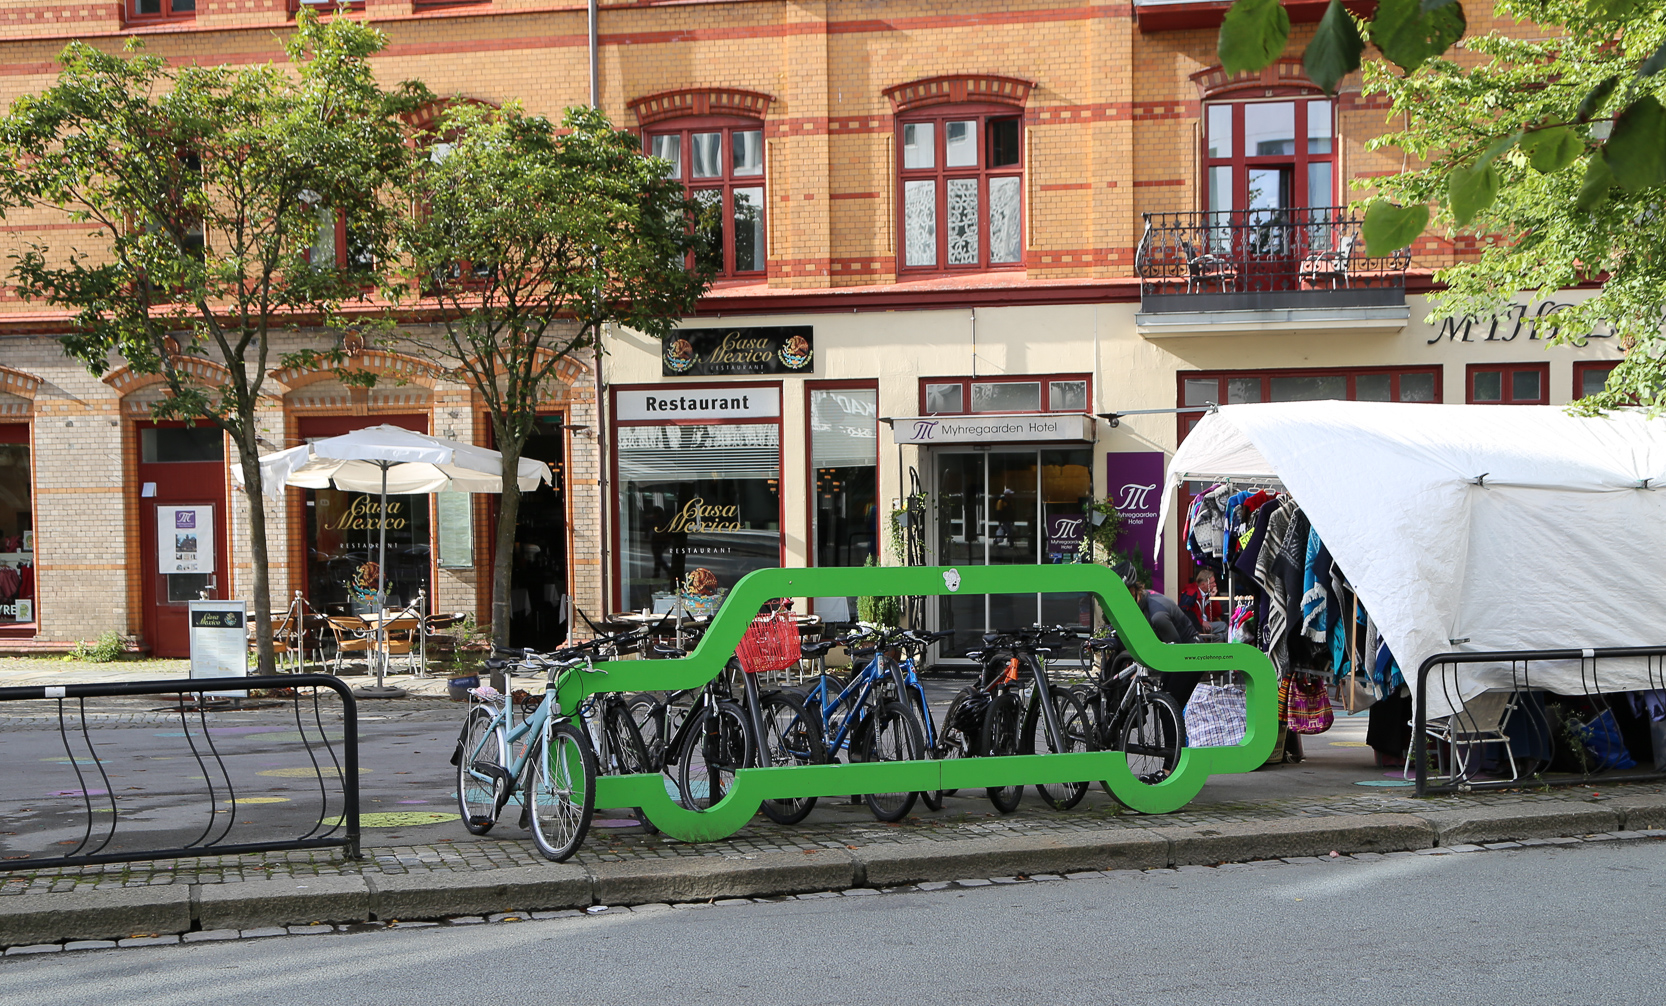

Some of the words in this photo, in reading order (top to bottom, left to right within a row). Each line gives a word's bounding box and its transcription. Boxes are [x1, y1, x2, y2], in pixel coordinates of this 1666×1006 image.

[721, 331, 770, 350] Casa
[698, 343, 775, 365] Mexico
[646, 395, 750, 411] Restaurant
[941, 423, 1024, 436] Myhregaarden
[1029, 422, 1058, 432] Hotel
[683, 497, 738, 519] Casa
[654, 511, 745, 533] Mexico
